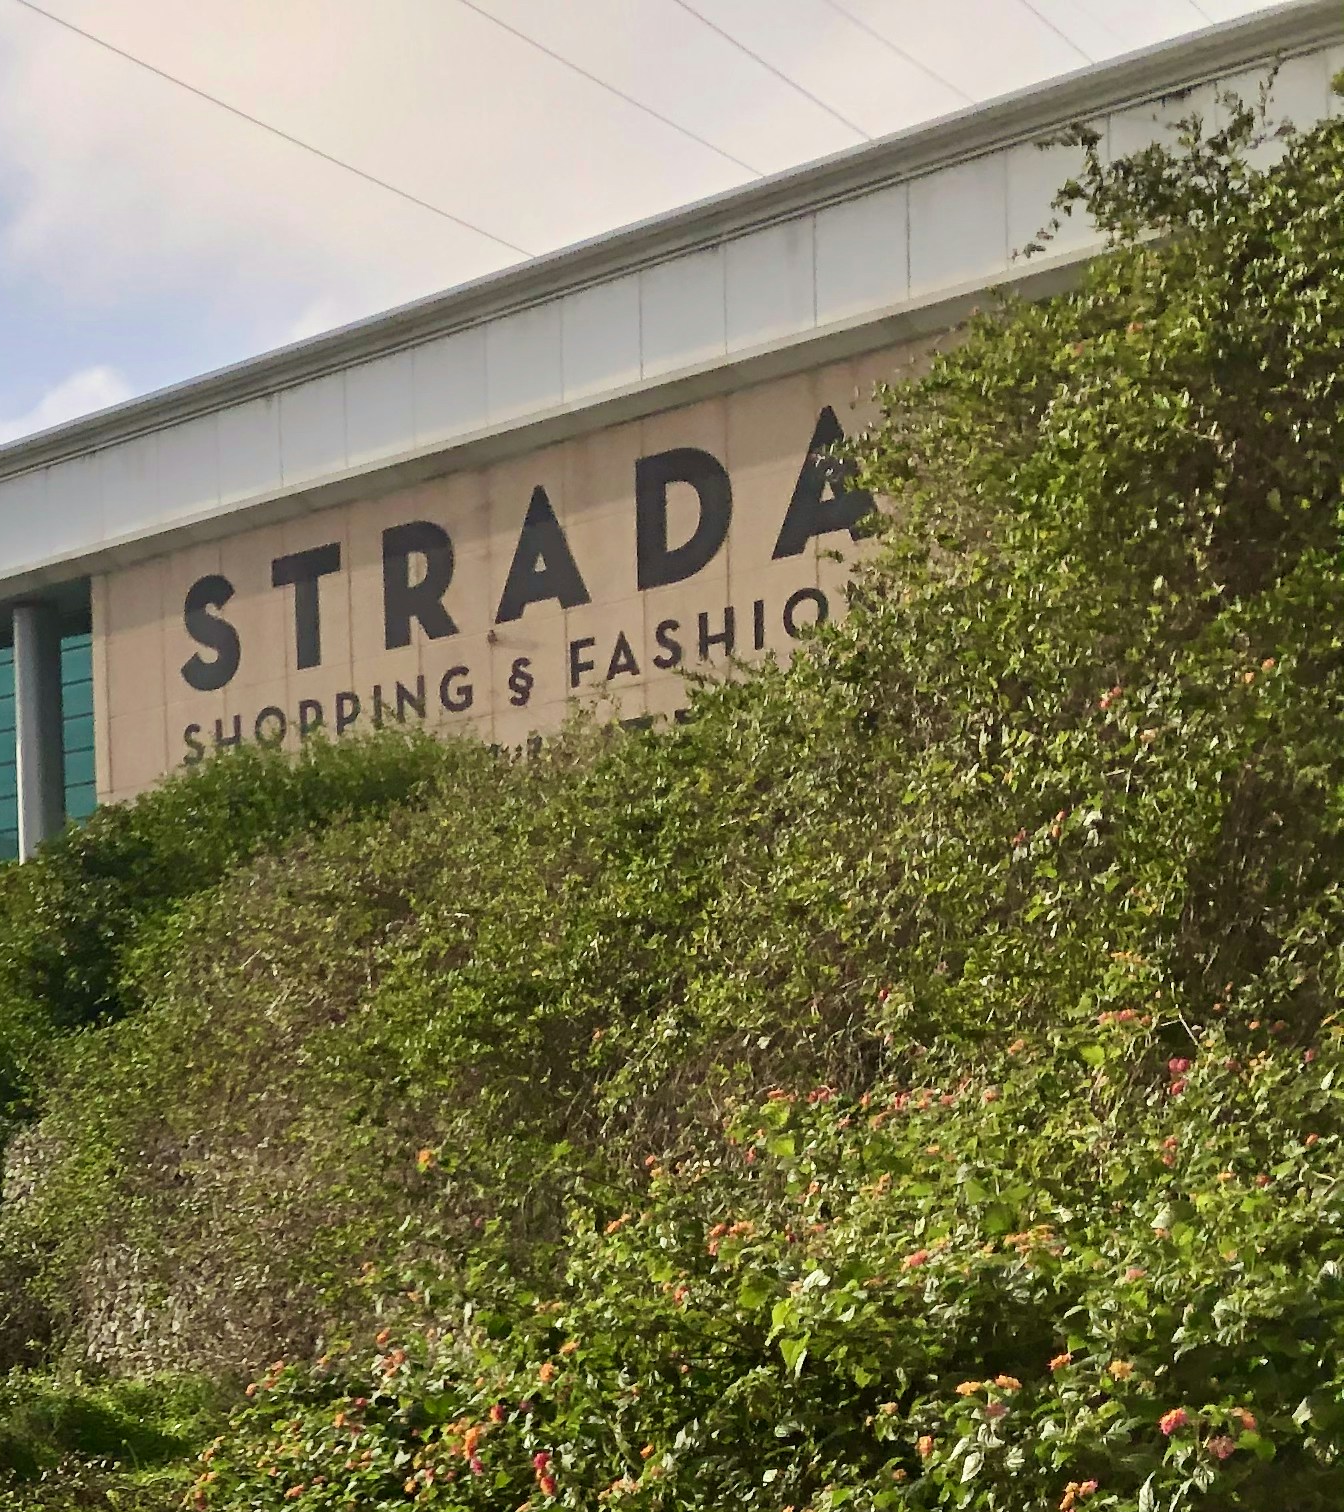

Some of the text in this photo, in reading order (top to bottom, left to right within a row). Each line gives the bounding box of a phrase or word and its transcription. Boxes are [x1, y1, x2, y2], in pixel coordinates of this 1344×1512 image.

[179, 404, 879, 693] STRADA
[182, 665, 475, 766] SHOPPING
[569, 587, 831, 689] FASHIO
